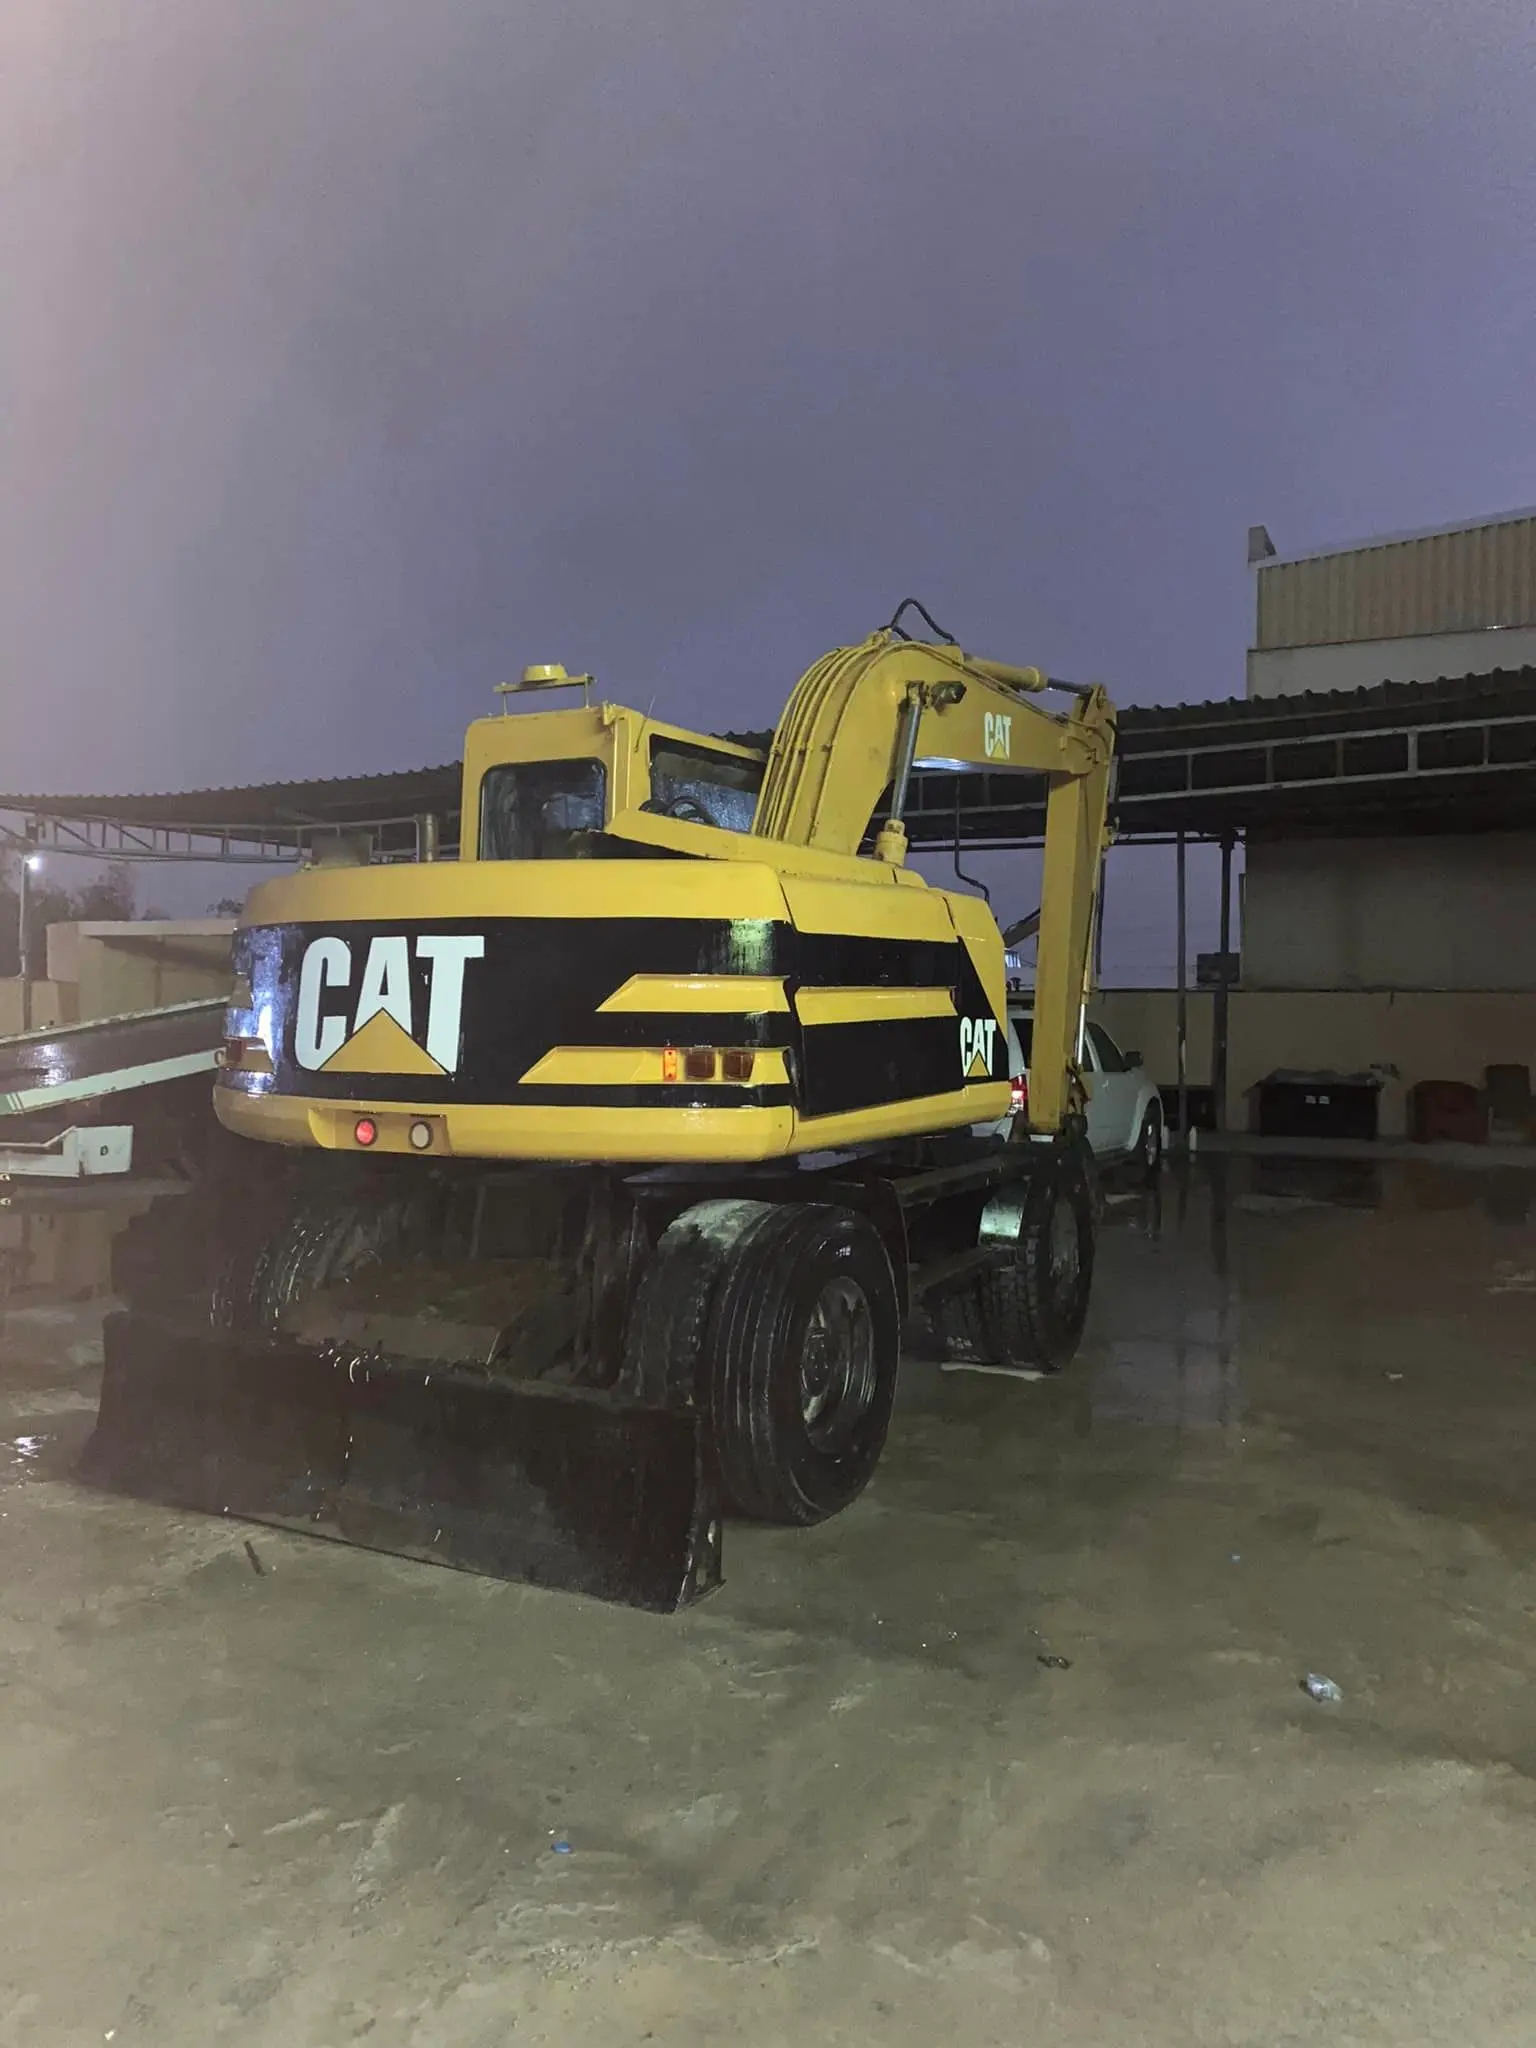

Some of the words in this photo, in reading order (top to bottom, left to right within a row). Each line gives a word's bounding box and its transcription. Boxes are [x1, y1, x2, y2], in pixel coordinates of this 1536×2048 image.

[984, 711, 1012, 760] CAT
[294, 935, 485, 1073] CAT
[959, 1016, 997, 1077] CAT
